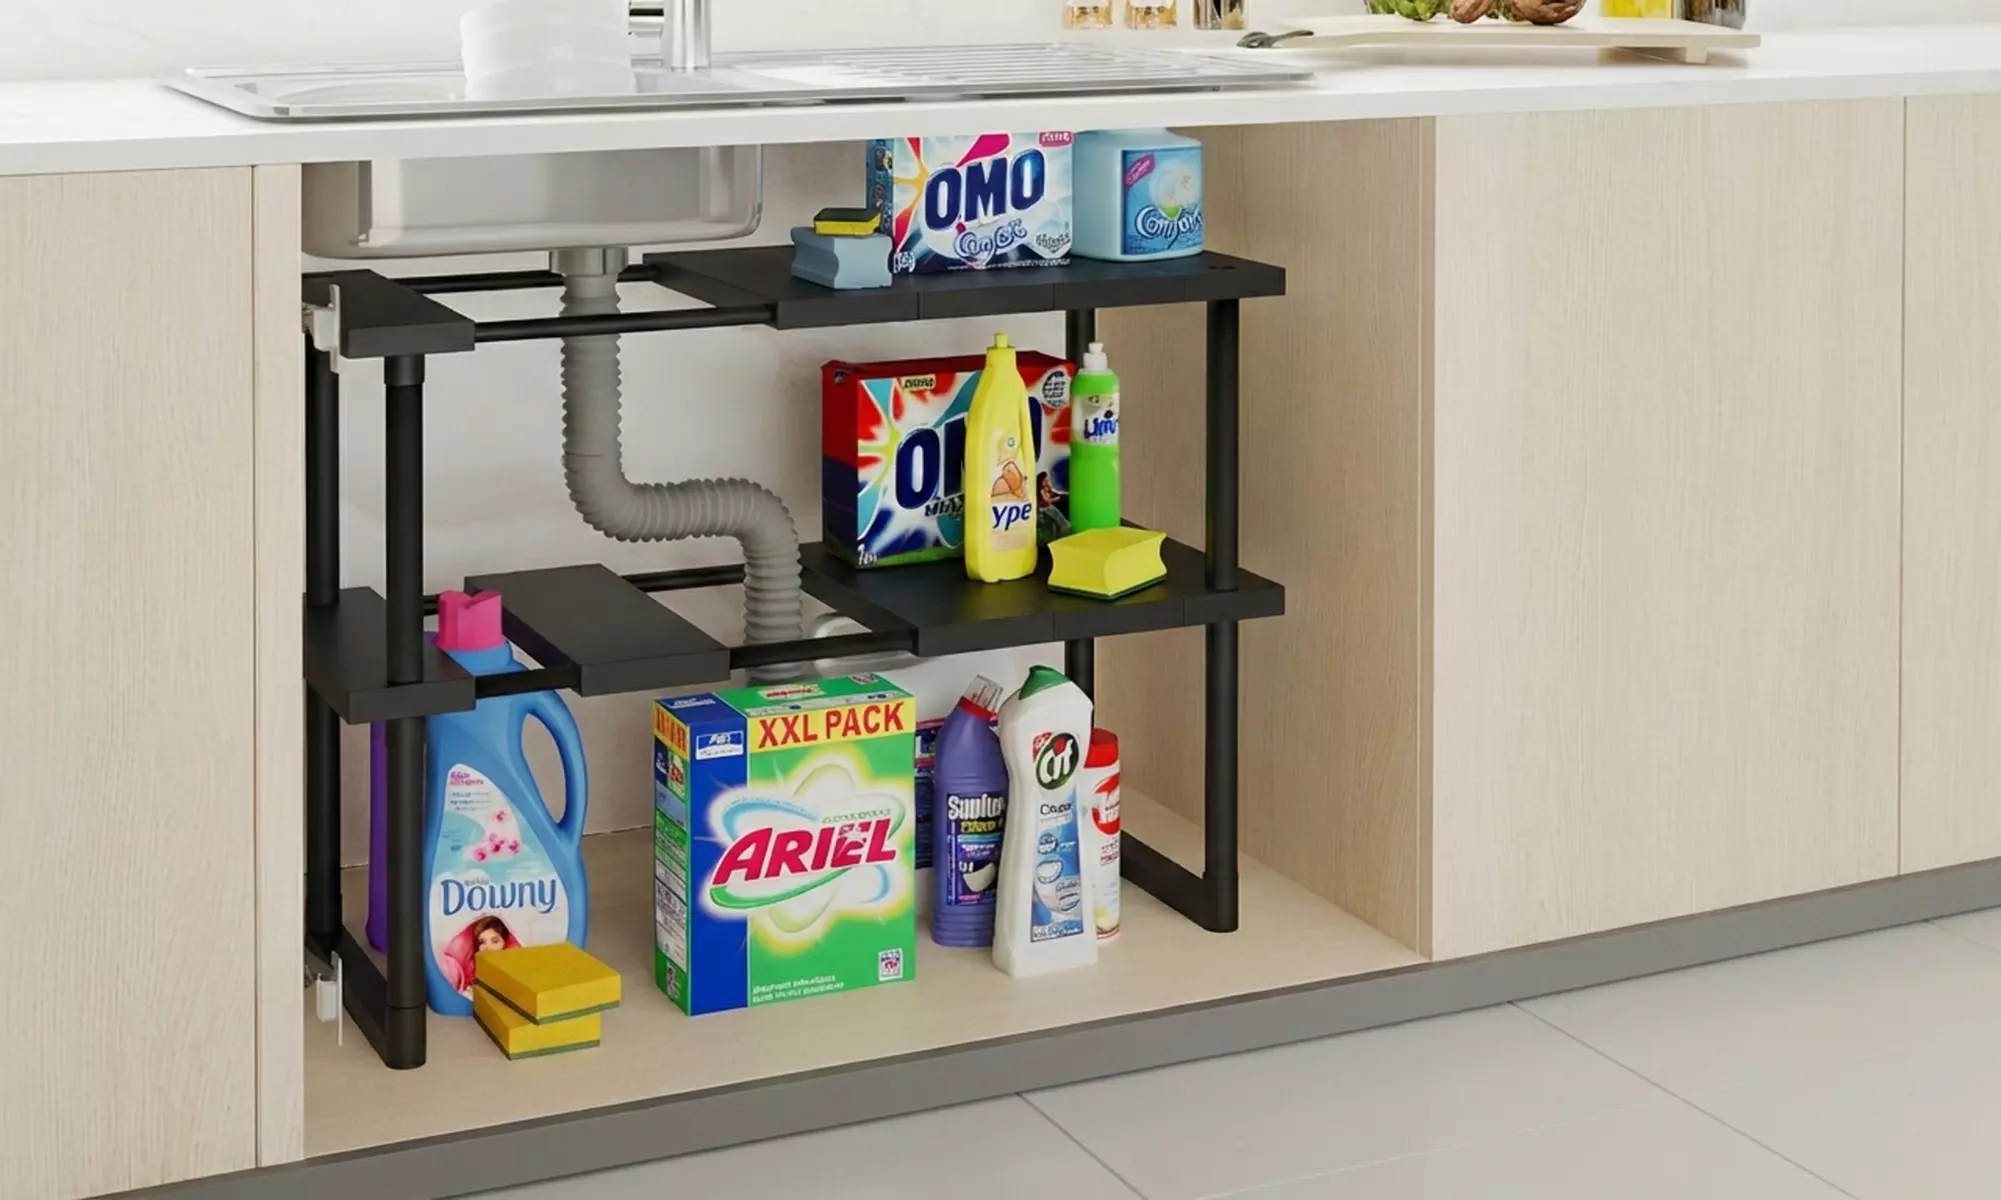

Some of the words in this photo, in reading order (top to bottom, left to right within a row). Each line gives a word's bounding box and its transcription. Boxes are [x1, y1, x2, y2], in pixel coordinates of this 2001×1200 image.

[924, 148, 1046, 232] OMO
[758, 713, 818, 749] XXL
[824, 701, 905, 741] PACK
[711, 818, 897, 886] ARIEL
[441, 878, 558, 917] Downy
